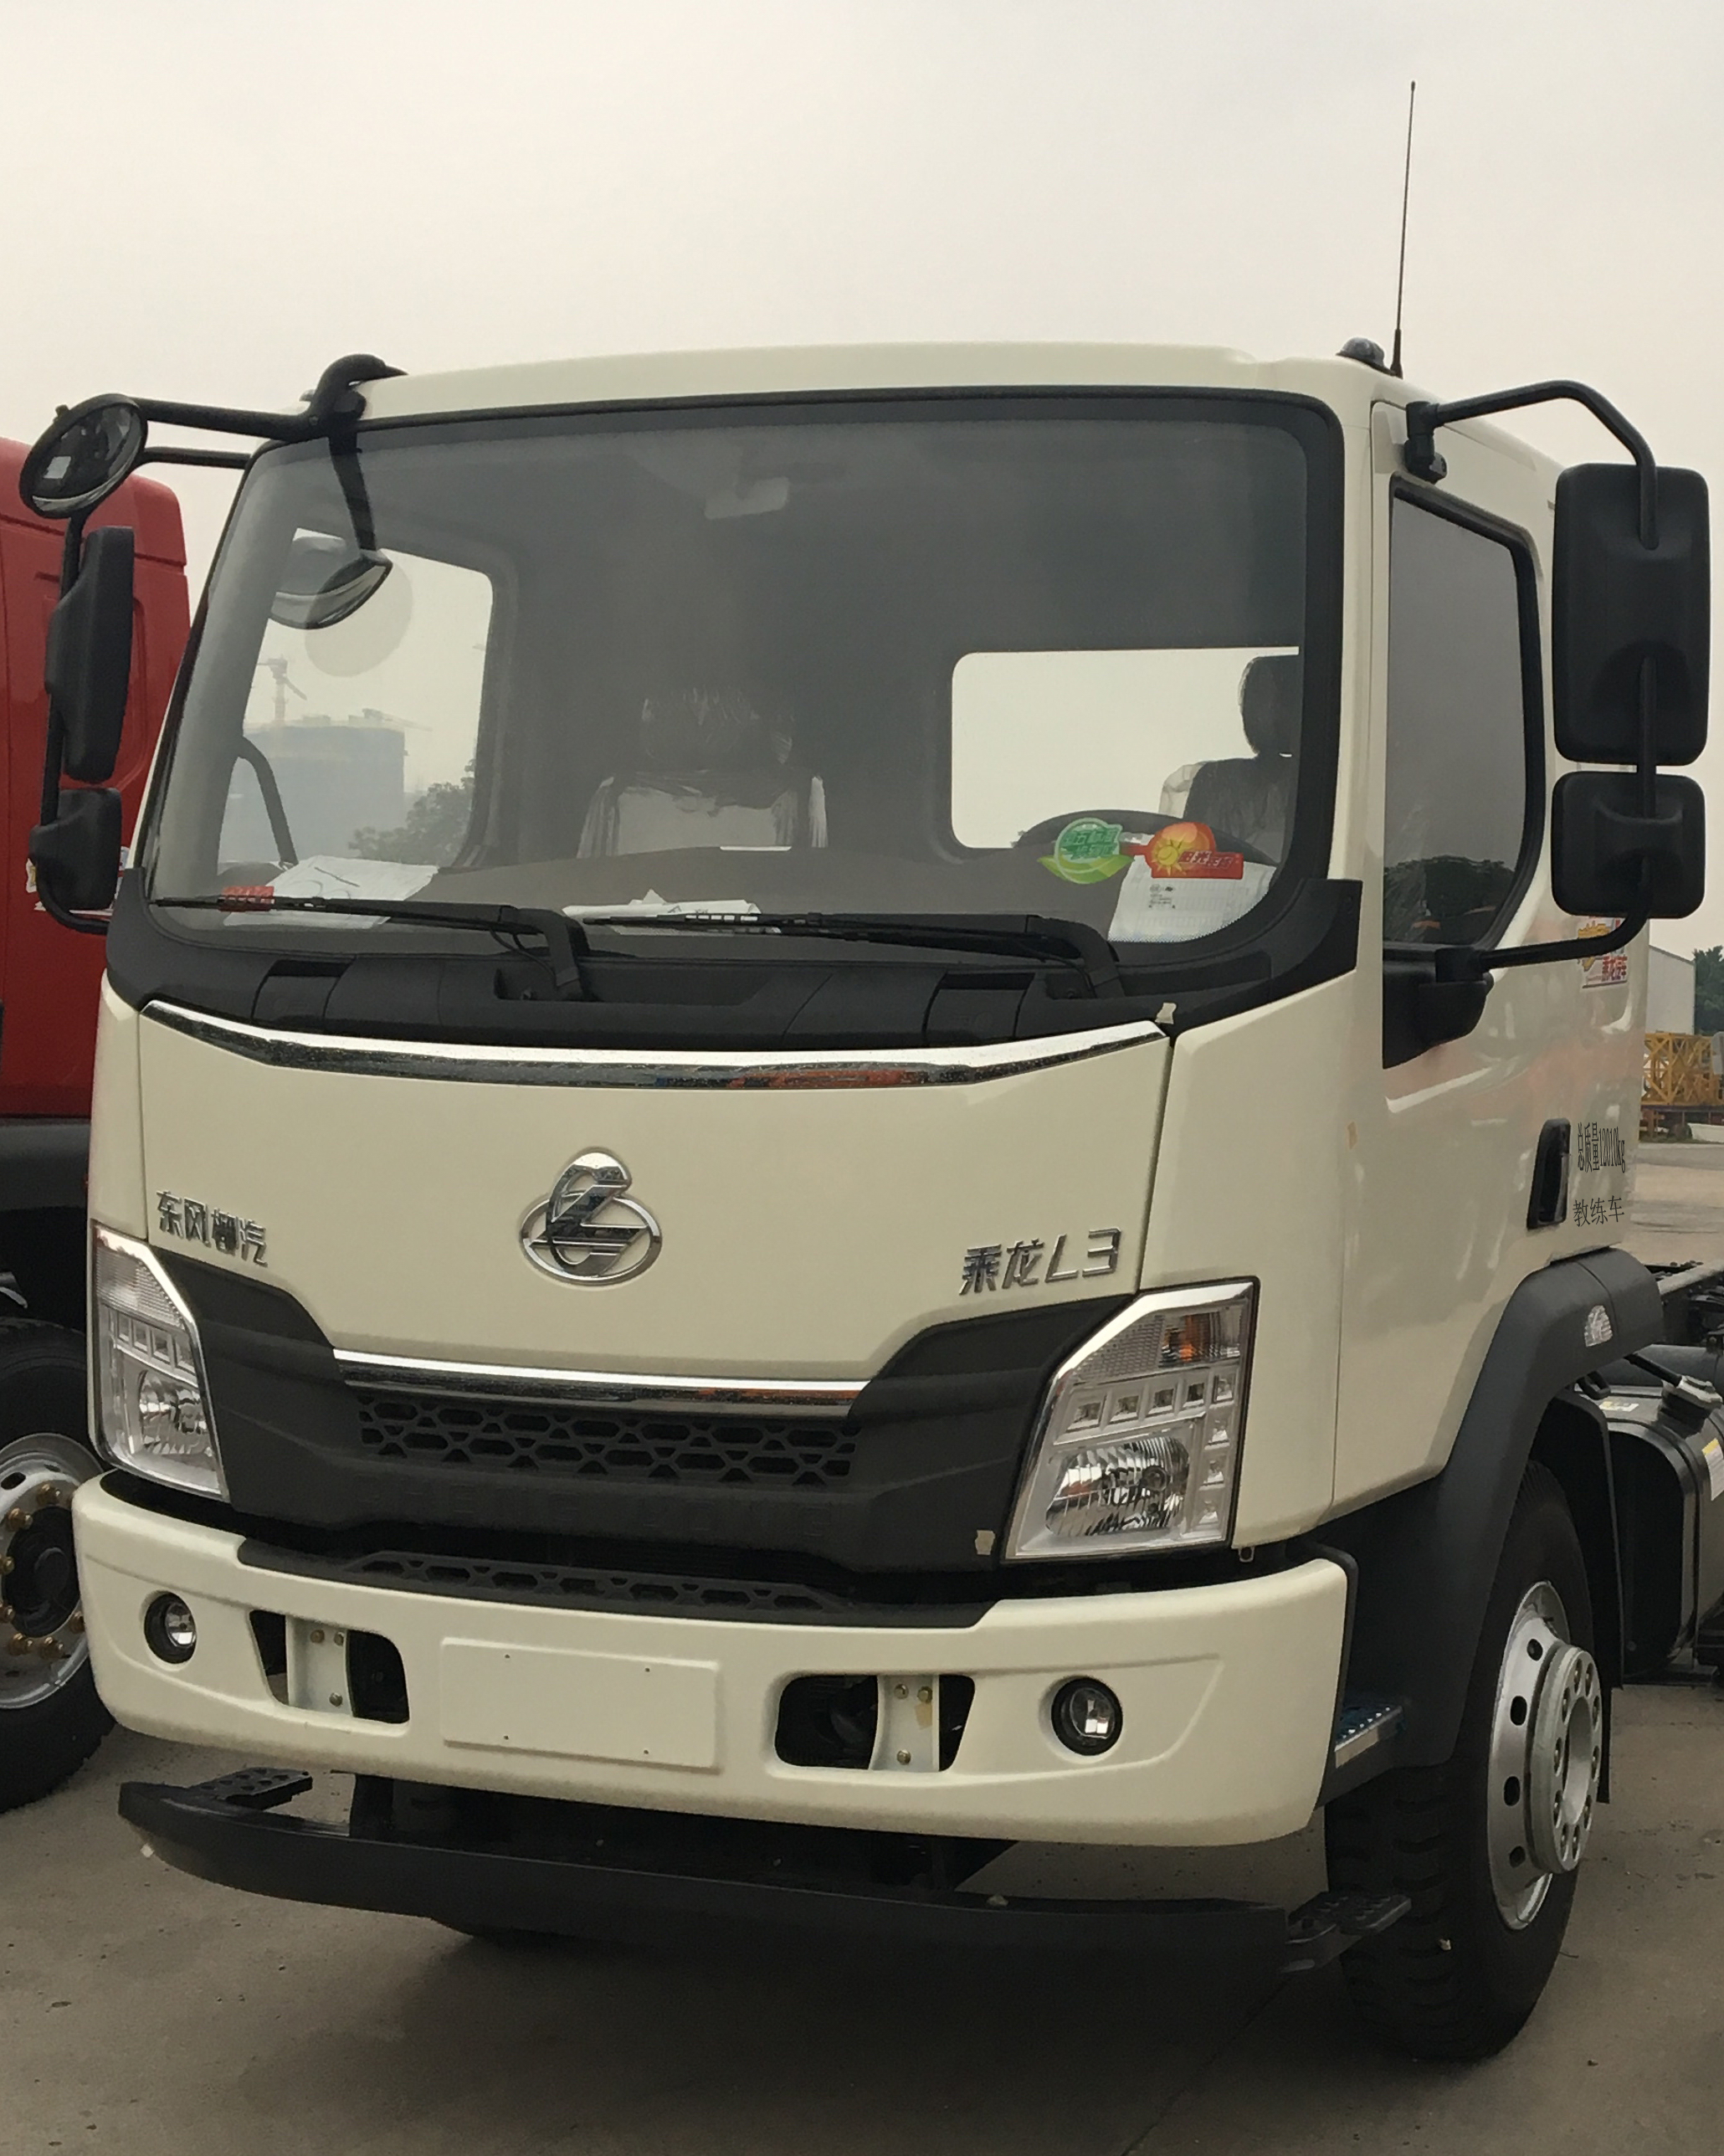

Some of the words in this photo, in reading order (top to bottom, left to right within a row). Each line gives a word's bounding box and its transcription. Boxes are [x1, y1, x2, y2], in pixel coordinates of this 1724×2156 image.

[156, 1189, 268, 1267] 东风柳汽
[1573, 1195, 1624, 1227] 教练车
